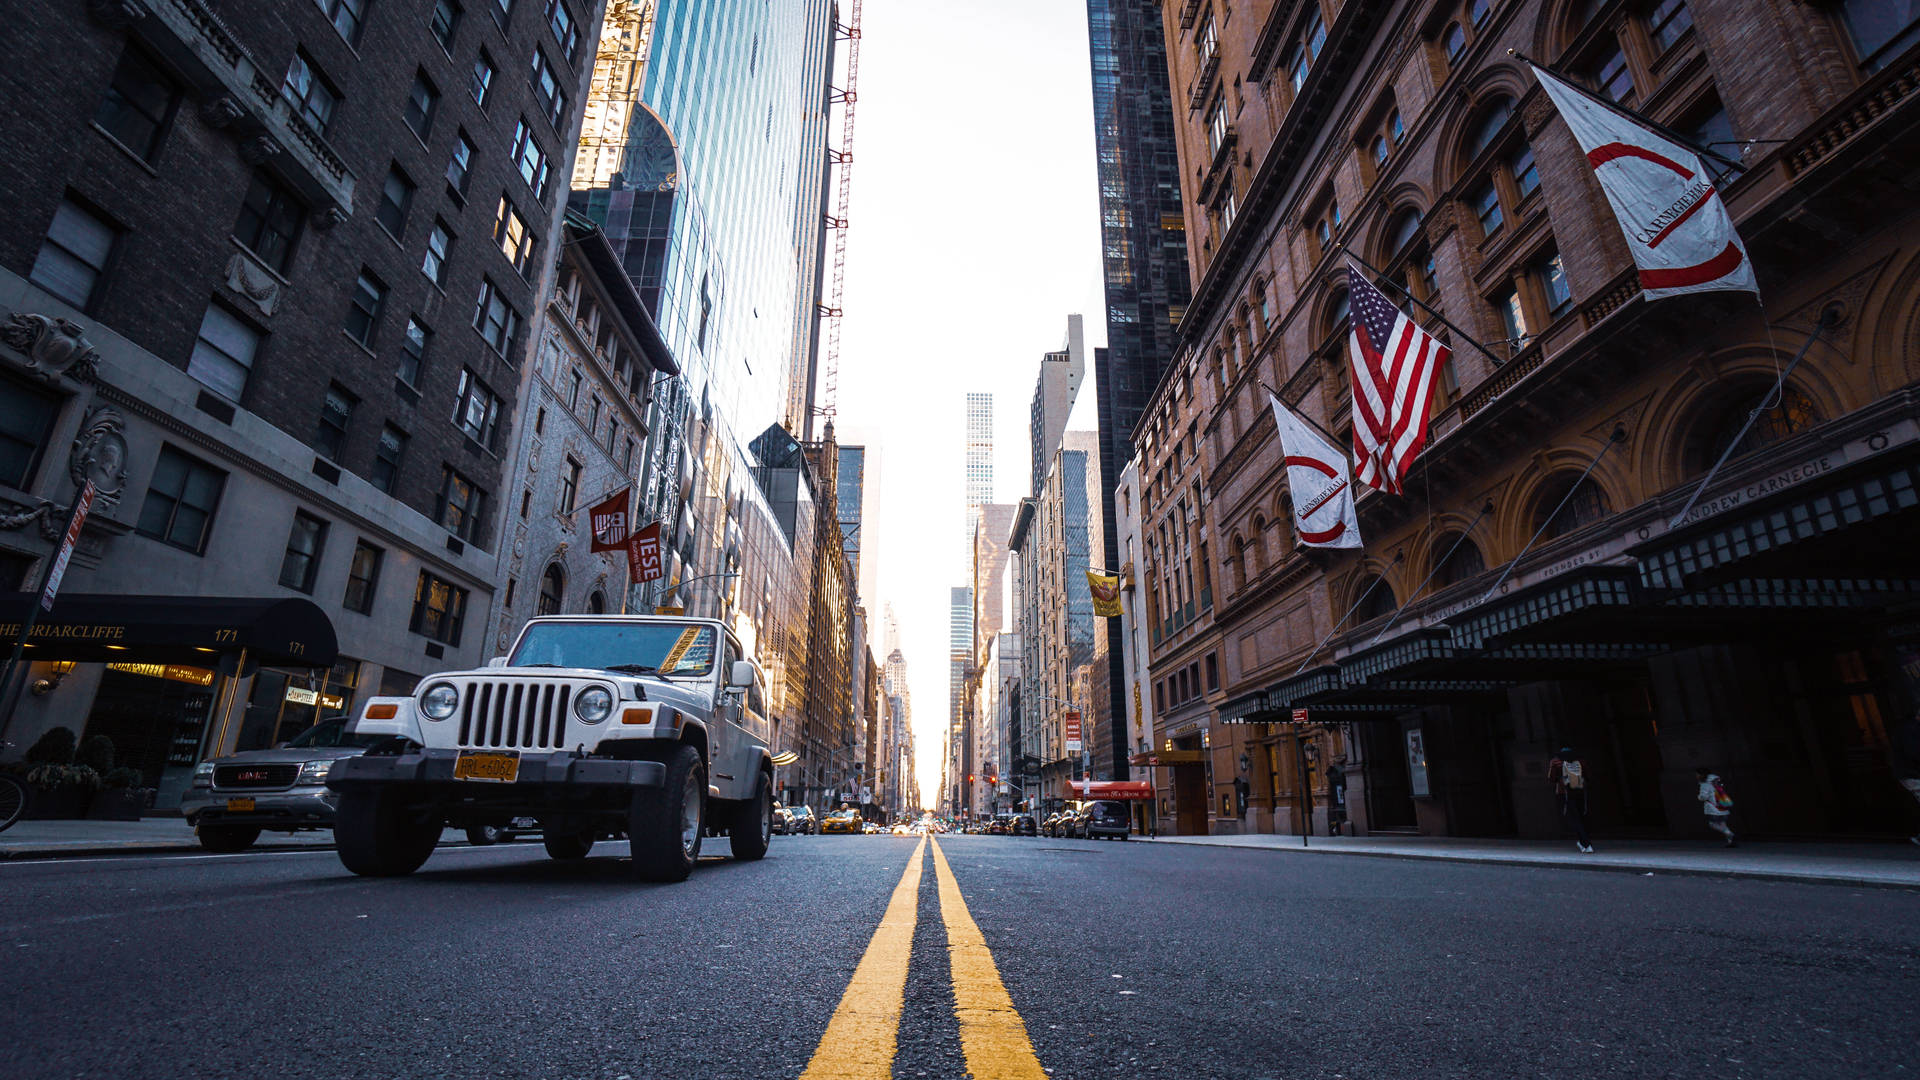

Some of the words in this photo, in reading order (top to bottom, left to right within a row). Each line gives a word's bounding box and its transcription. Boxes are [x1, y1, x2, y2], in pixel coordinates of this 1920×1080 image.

[1637, 194, 1695, 244] CARNEGIE
[1297, 490, 1330, 517] CARNEGIE
[1327, 477, 1346, 494] HALL
[1681, 493, 1740, 525] ANDREW
[1747, 458, 1831, 498] CARNEGIE
[640, 537, 660, 580] IESE
[1589, 551, 1600, 560] BY
[28, 624, 124, 639] BRIARCLIFFE
[216, 629, 238, 642] 171
[289, 641, 304, 656] 171
[237, 771, 268, 780] GMC
